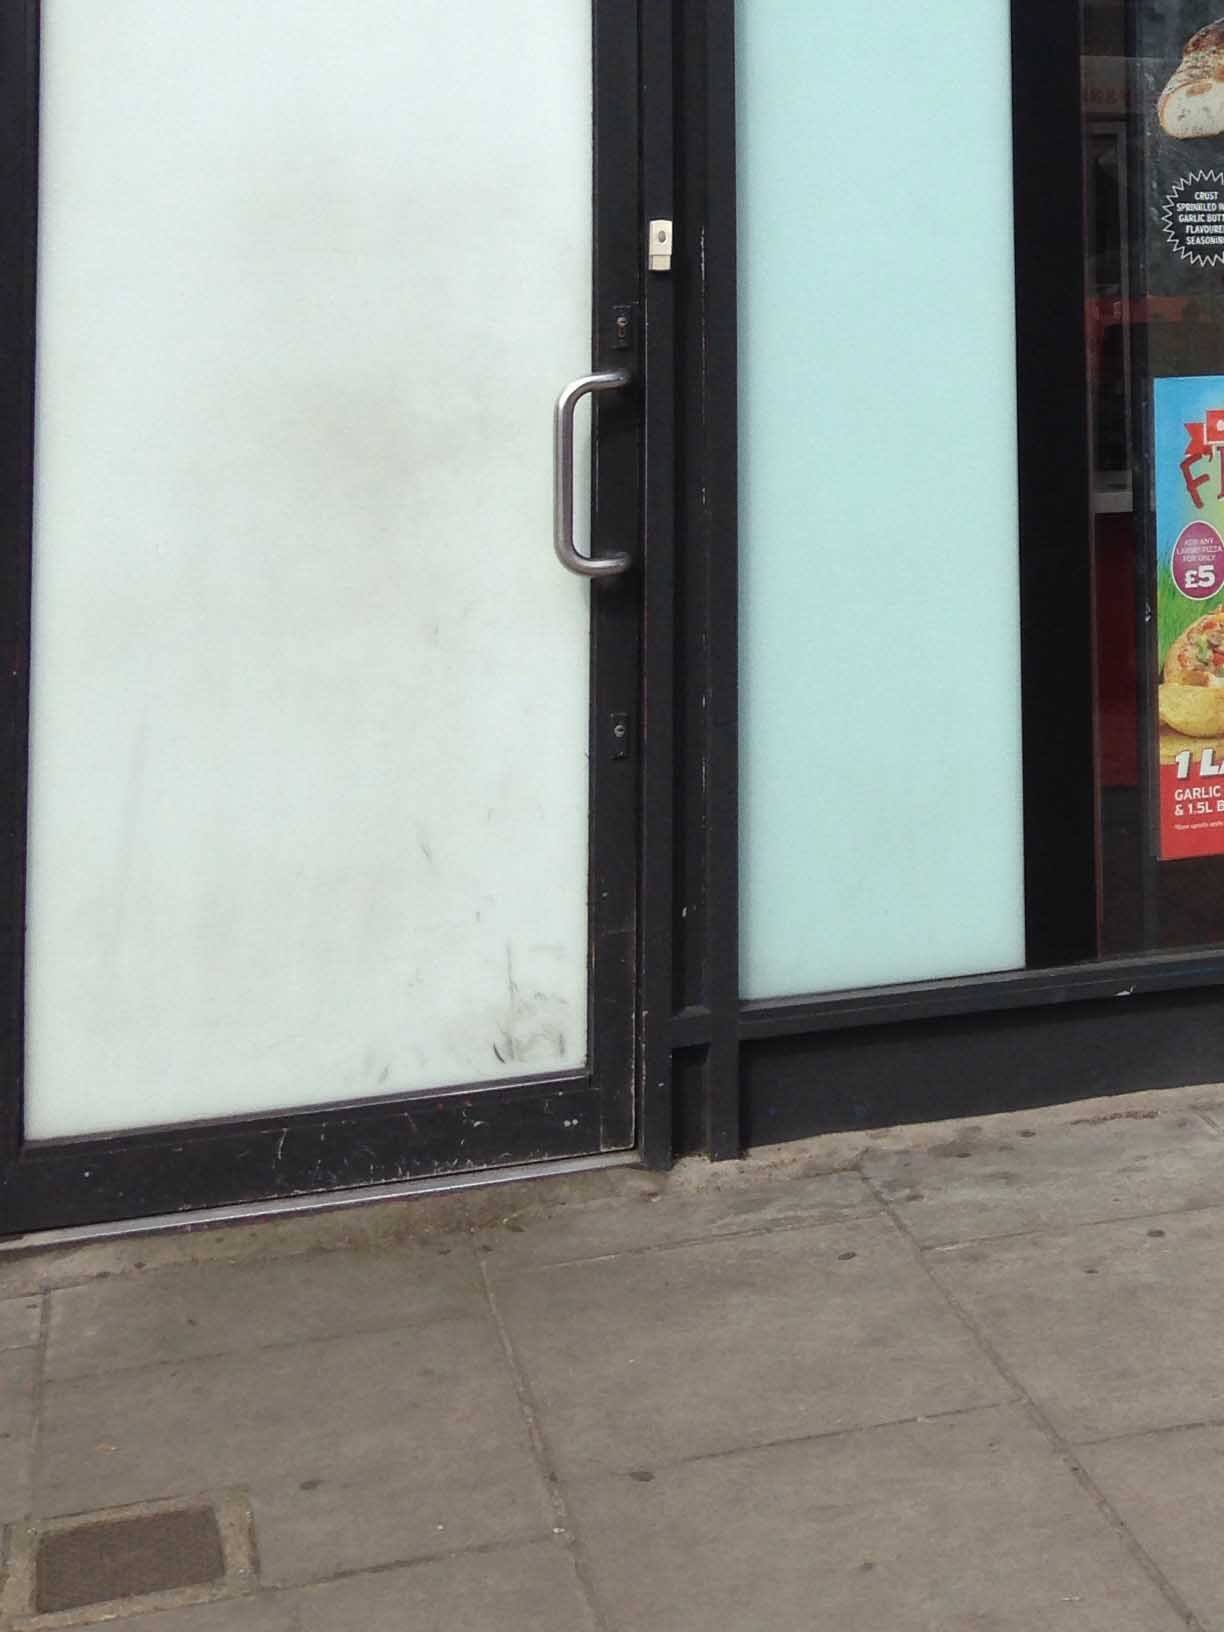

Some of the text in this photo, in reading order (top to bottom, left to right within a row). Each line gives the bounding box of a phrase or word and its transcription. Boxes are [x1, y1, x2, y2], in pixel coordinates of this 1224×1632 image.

[1194, 191, 1219, 200] CRUST
[1178, 213, 1205, 223] GARLIC
[1184, 564, 1216, 588] £5
[1175, 750, 1191, 779] 1
[1174, 784, 1221, 801] GARLIC
[1174, 803, 1184, 816] &
[1187, 799, 1213, 814] 1.5L
